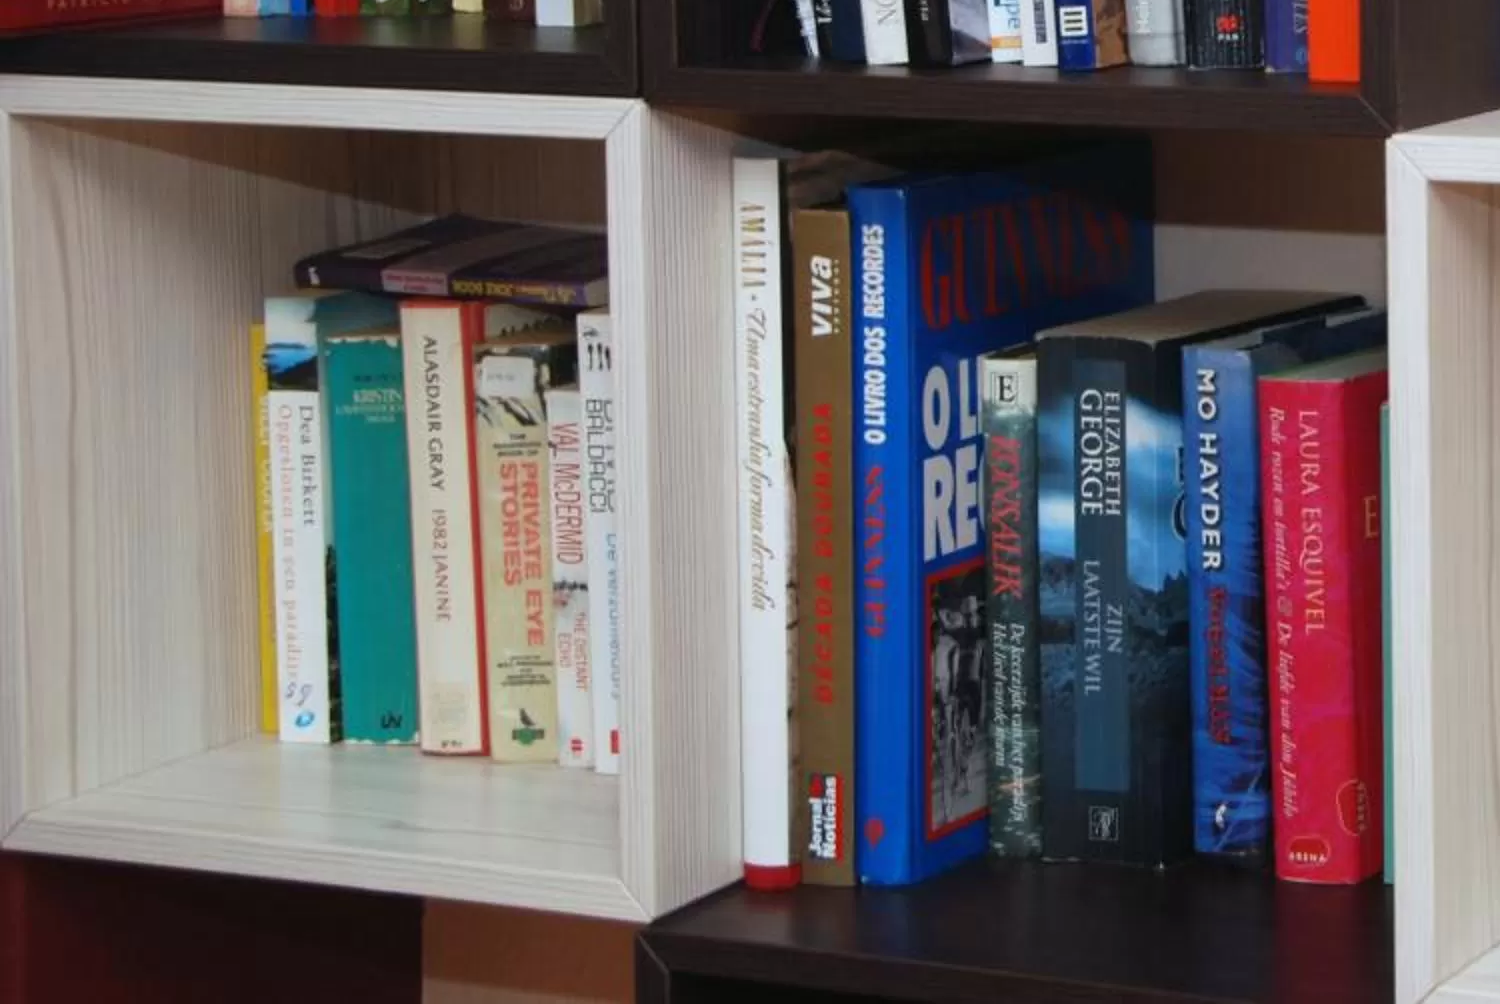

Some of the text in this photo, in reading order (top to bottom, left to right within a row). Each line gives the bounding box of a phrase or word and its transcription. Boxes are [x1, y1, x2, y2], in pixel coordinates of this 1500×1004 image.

[811, 255, 833, 338] viva
[862, 224, 887, 444] O LIVRO DOS RECORDES
[922, 366, 950, 450] O
[998, 375, 1016, 403] E
[1196, 369, 1217, 420] MO
[299, 405, 316, 527] Dea Birkett
[423, 335, 450, 622] ALASDAIR GRAY 1982 JANINE
[552, 423, 583, 565] VAL McDERMID
[585, 398, 607, 514] BALDACCI
[1080, 388, 1103, 516] GEORGE
[1104, 391, 1122, 516] ELIZABETH
[1198, 432, 1222, 570] HAYDER
[500, 462, 522, 587] STORIES
[522, 462, 544, 648] PRIVATE EYE
[991, 435, 1023, 600] KONSALIK
[1299, 409, 1325, 636] LAURA ESQUIVEL
[1083, 560, 1101, 696] LAATSTE WIL
[1104, 603, 1124, 654] ZIJN
[808, 798, 822, 854] Jornal
